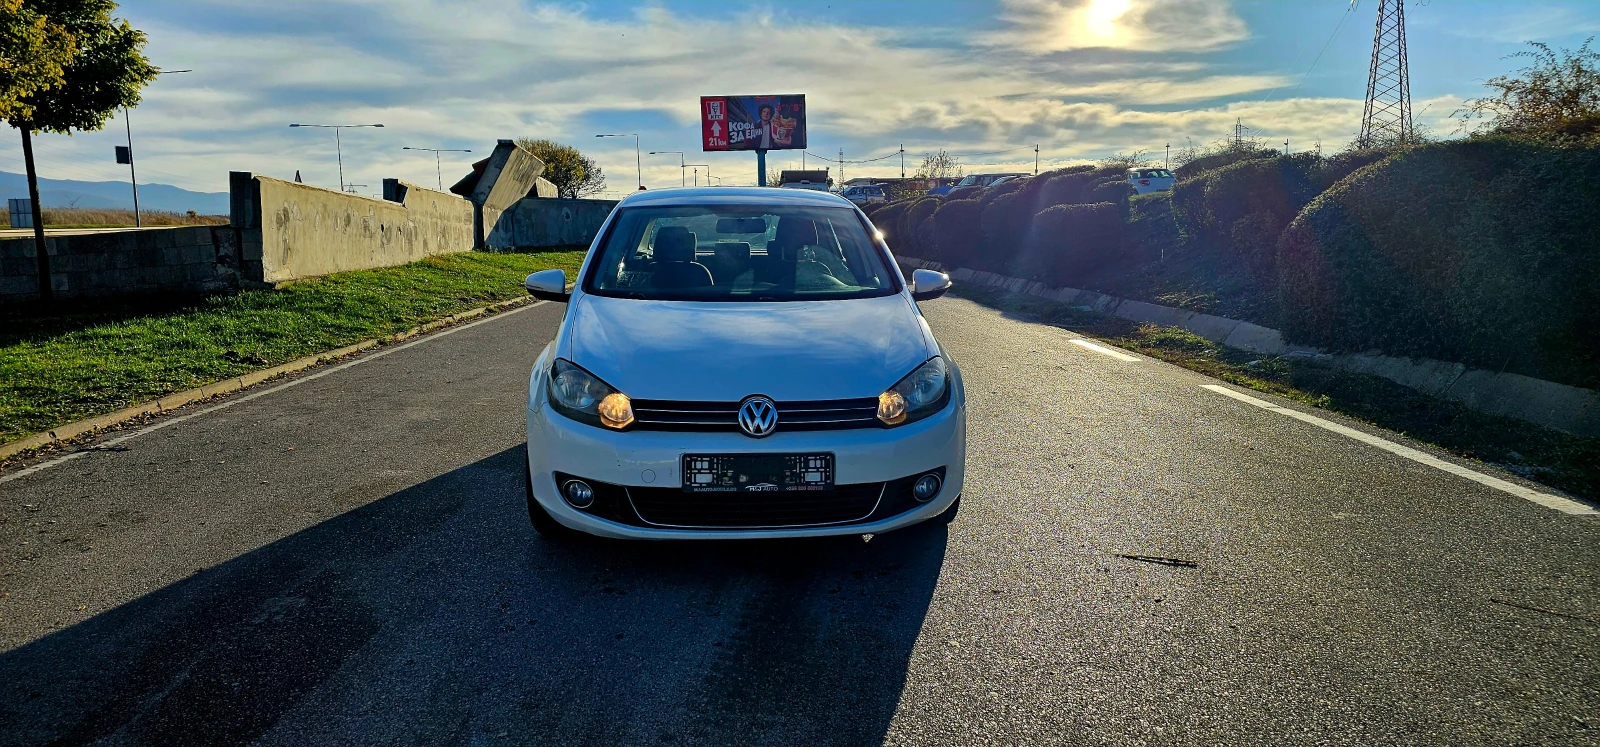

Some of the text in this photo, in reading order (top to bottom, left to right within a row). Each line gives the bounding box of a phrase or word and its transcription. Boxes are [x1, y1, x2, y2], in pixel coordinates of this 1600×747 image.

[729, 121, 755, 131] КОФА
[708, 137, 717, 146] 21
[729, 128, 763, 143] ЗА ЕДИН
[739, 396, 777, 435] VW
